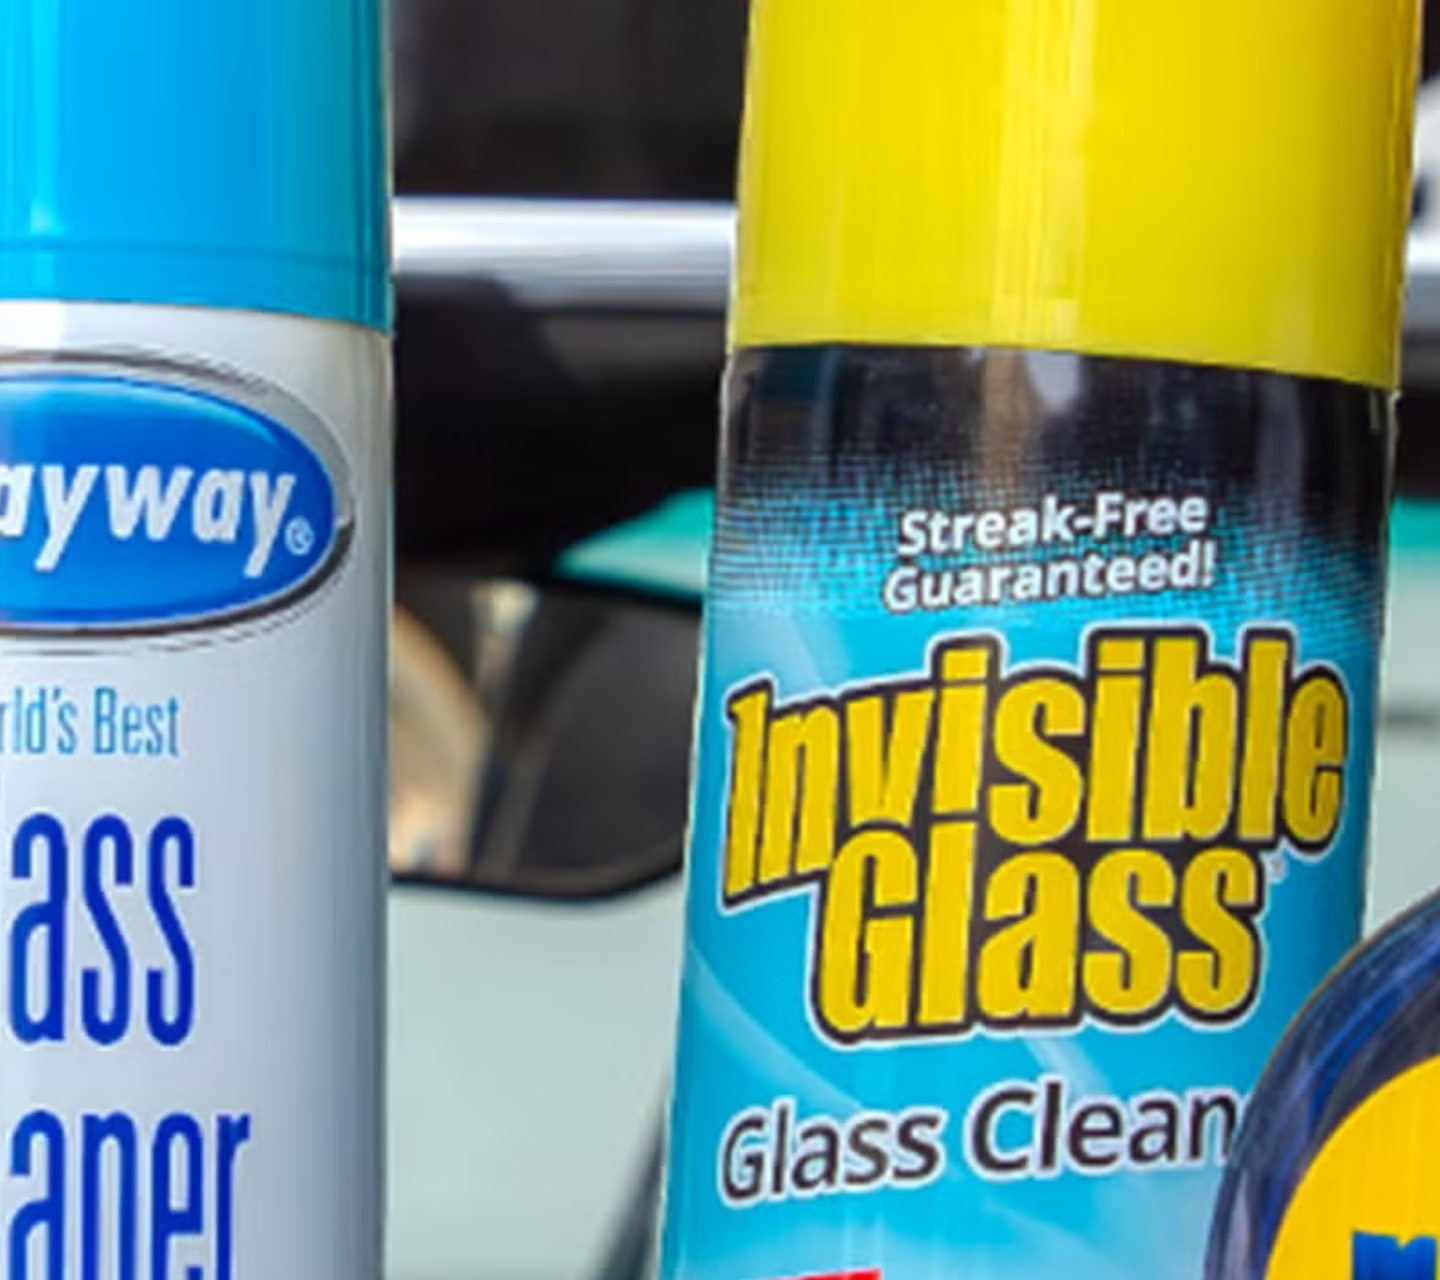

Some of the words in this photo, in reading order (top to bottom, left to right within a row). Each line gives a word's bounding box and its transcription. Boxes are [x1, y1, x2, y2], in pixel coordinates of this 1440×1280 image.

[897, 492, 1209, 556] Streak-Free
[883, 542, 1217, 614] Guaranteed!
[93, 686, 179, 757] Best
[722, 634, 1350, 904] Invisible
[820, 820, 1258, 1036] Glass
[722, 1102, 942, 1202] Glass
[968, 1081, 1236, 1175] Clean
